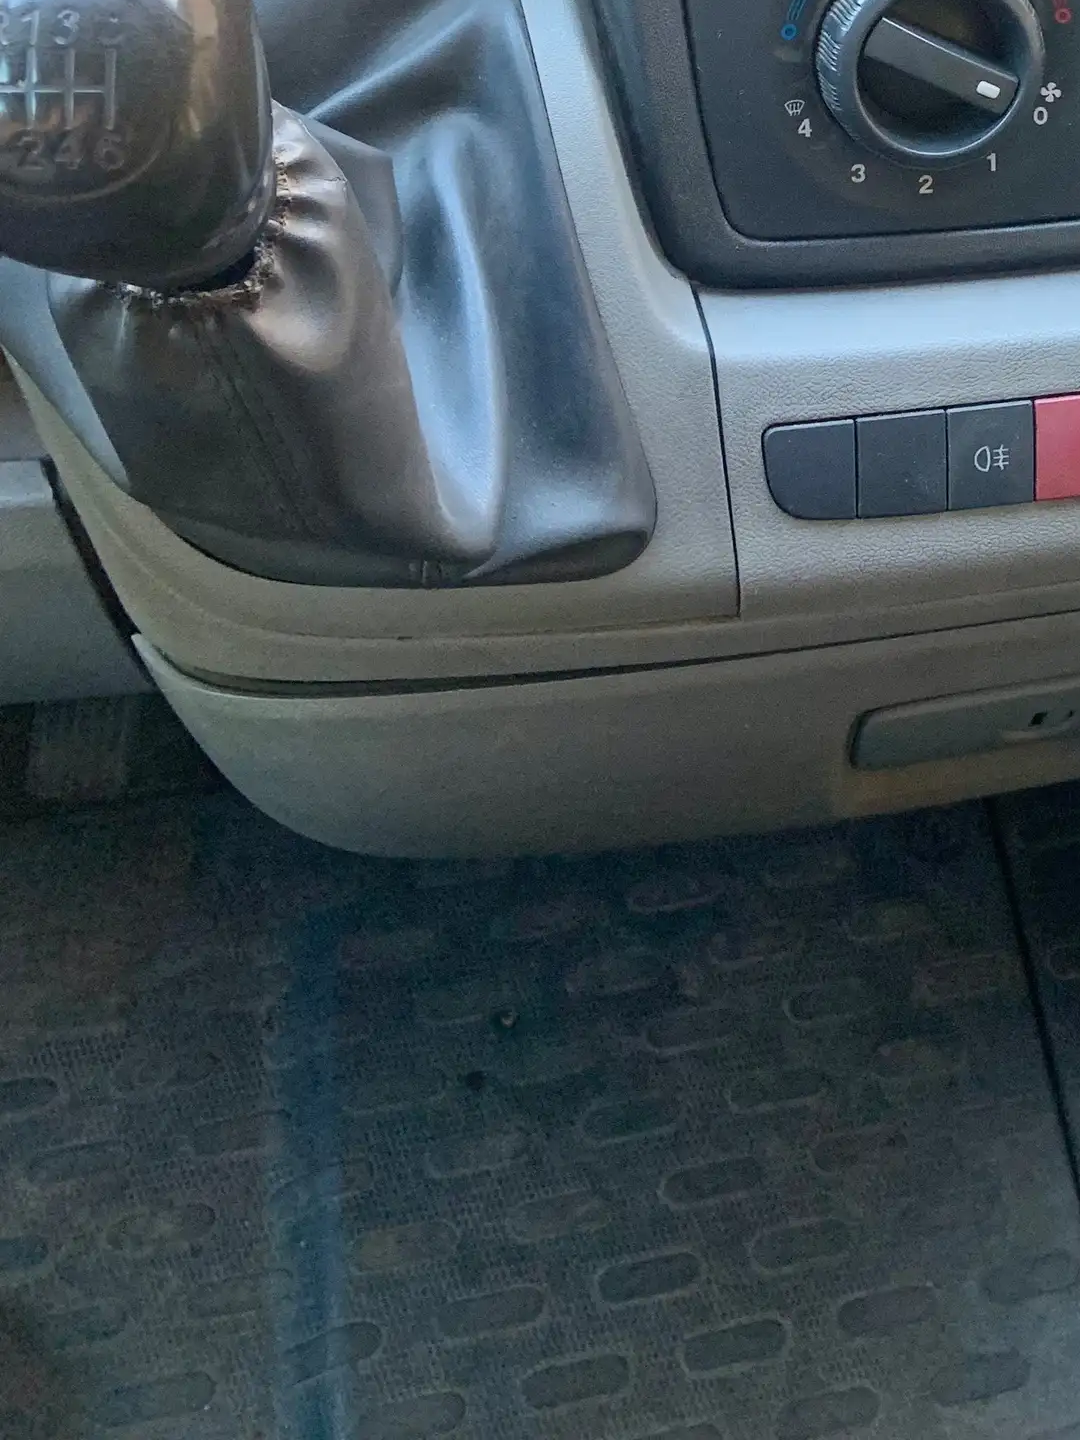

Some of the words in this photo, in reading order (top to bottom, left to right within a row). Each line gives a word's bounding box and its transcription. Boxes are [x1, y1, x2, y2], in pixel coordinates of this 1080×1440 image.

[53, 9, 81, 46] 3
[1033, 107, 1049, 125] 0
[798, 118, 813, 138] 4
[986, 152, 998, 172] 1
[850, 163, 866, 183] 3
[918, 174, 935, 195] 2
